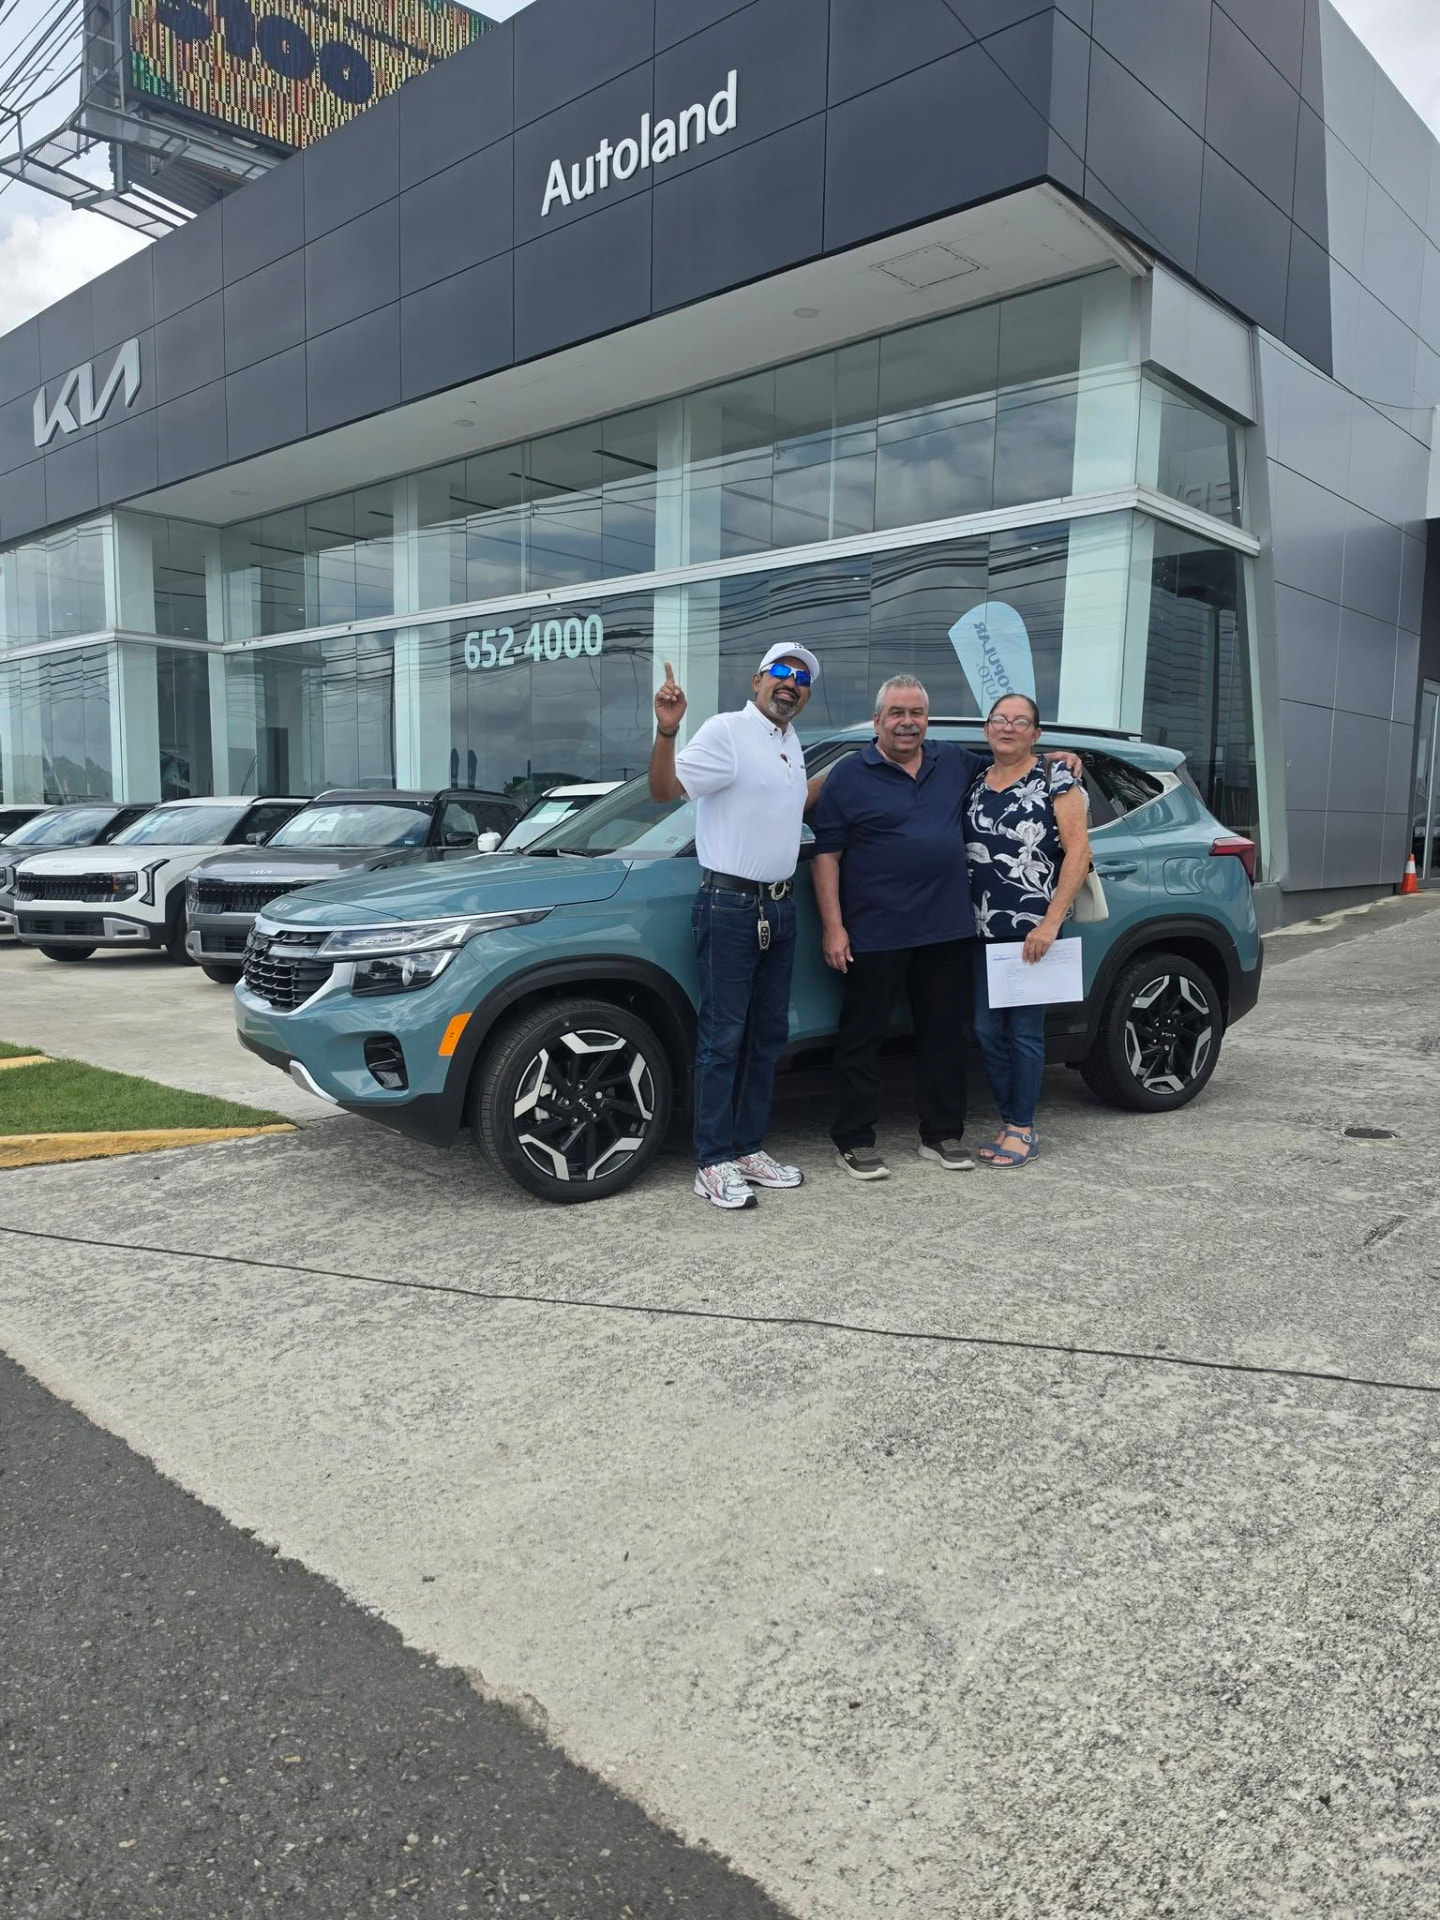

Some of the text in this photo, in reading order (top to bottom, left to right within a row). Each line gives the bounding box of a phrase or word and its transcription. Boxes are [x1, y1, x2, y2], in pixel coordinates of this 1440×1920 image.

[541, 69, 737, 217] Autoland
[33, 338, 141, 447] KIA
[464, 613, 604, 669] 652-4000
